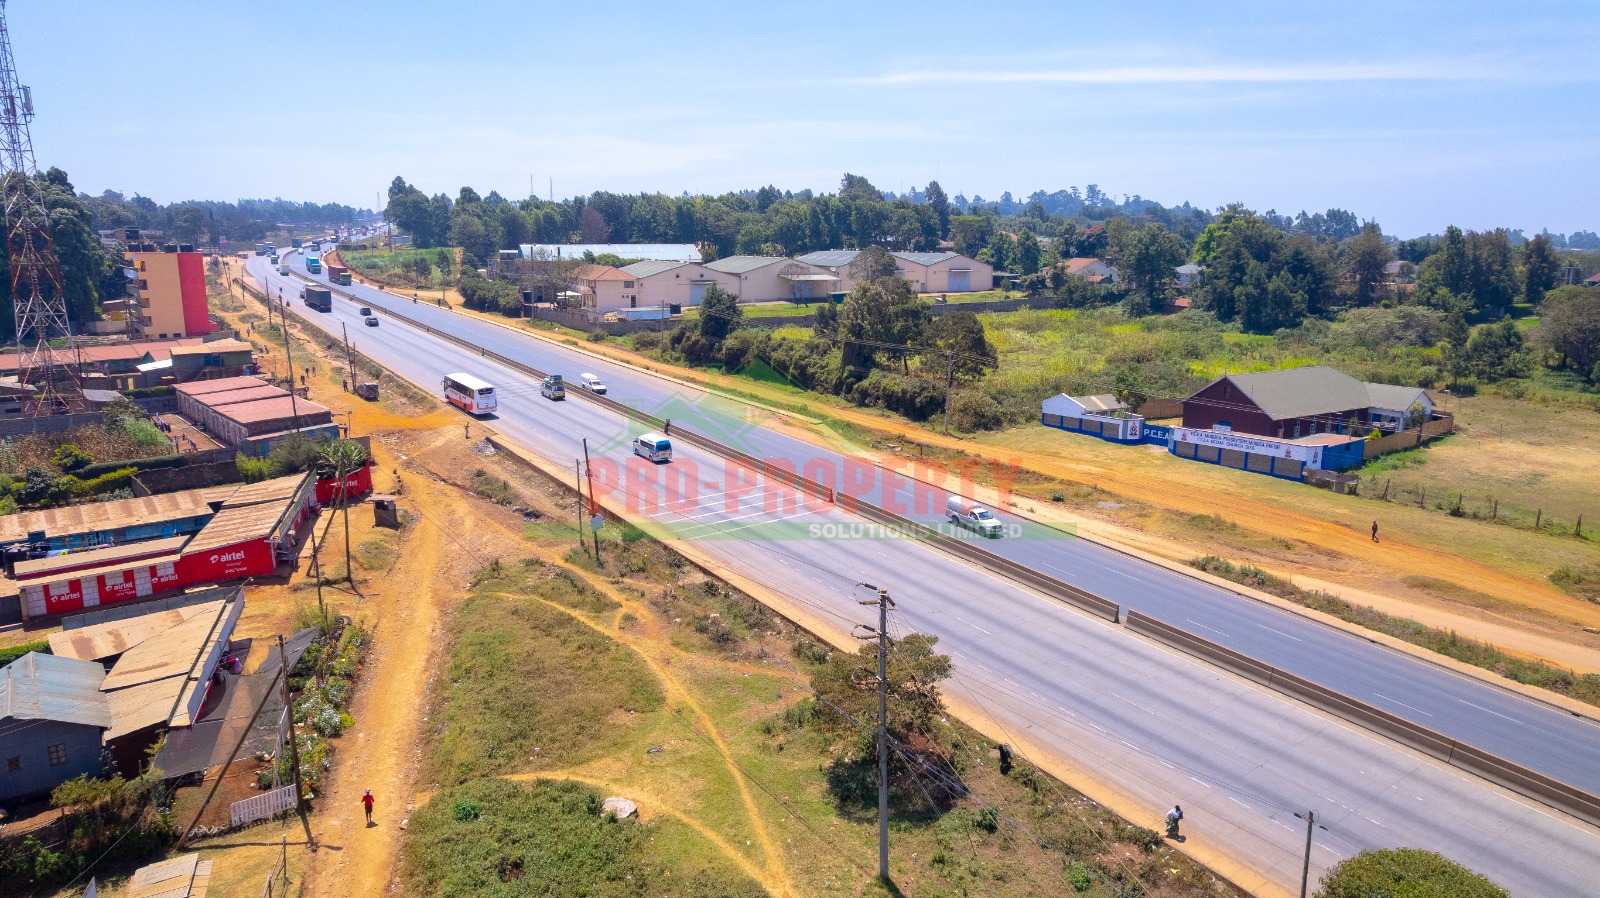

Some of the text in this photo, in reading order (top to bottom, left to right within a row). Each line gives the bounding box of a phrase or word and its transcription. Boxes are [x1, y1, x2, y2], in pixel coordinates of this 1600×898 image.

[220, 550, 245, 562] airtel
[158, 573, 179, 584] airtel
[113, 580, 134, 591] airtel
[60, 591, 81, 602] airtel
